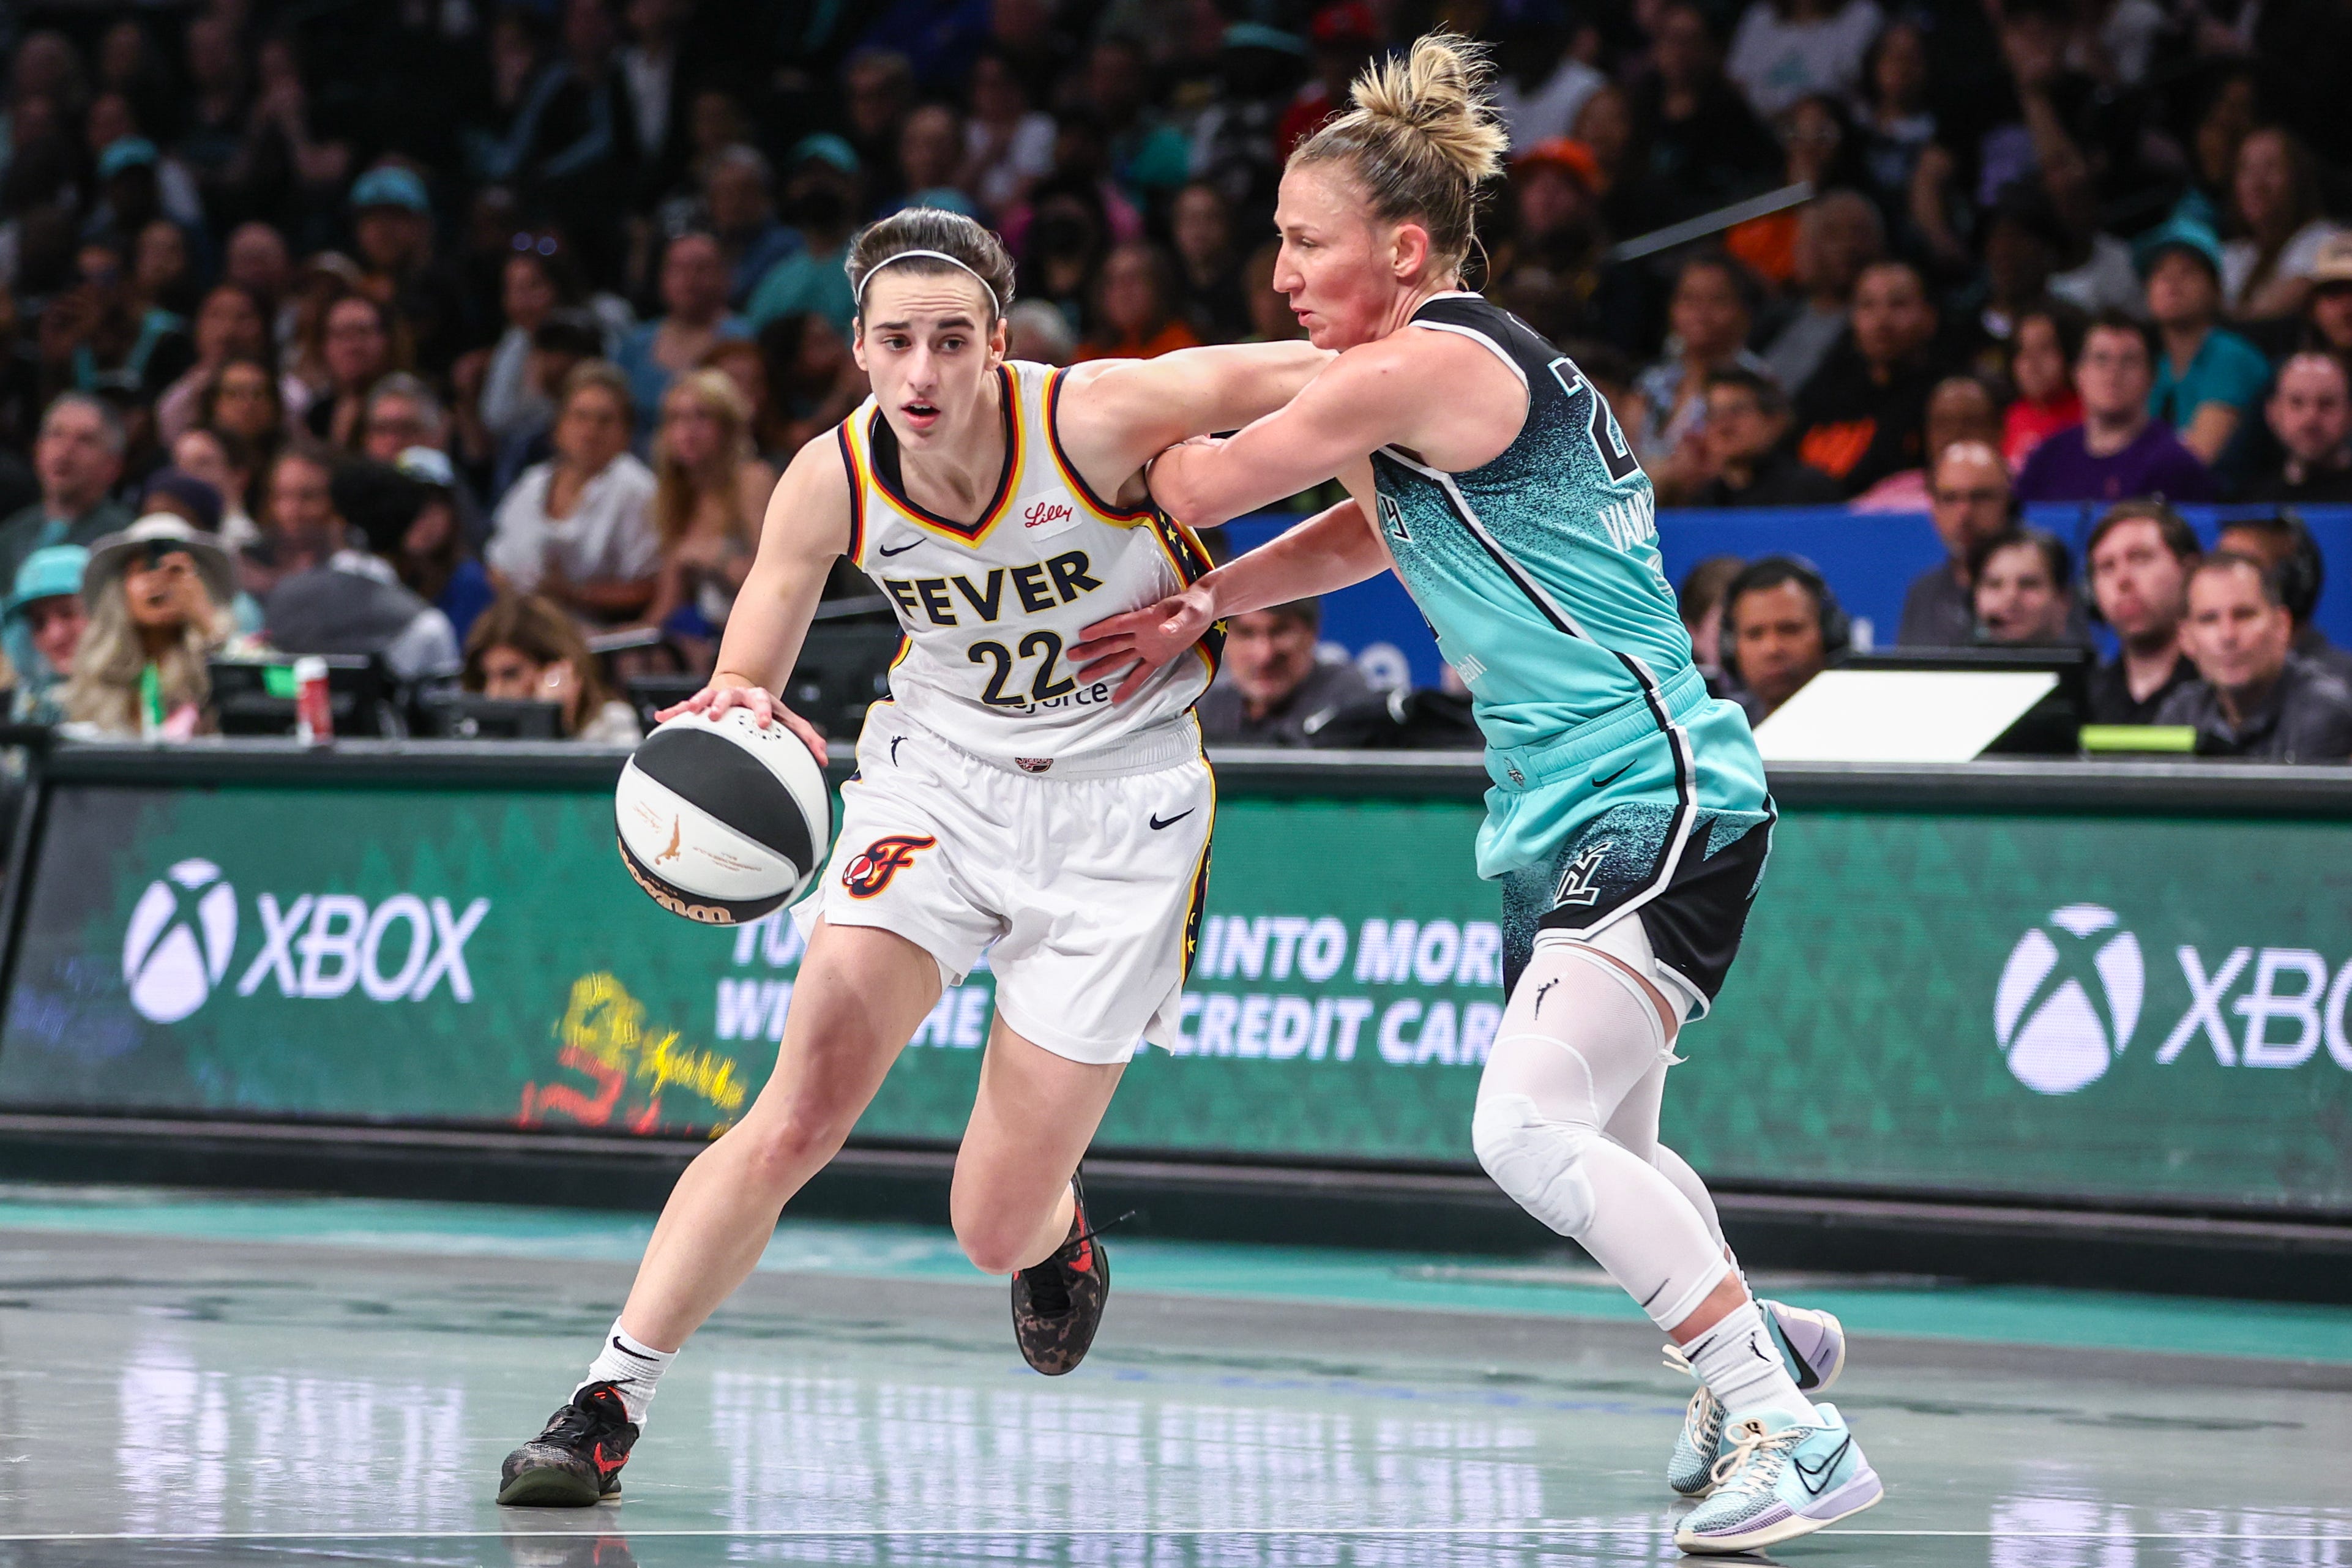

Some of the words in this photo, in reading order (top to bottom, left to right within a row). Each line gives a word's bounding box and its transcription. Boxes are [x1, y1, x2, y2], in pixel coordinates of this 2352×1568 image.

[1024, 501, 1073, 530] Lilly
[881, 550, 1103, 626] FEVER
[968, 629, 1077, 706] 22
[237, 892, 490, 1004] XBOX
[1197, 915, 1347, 983] INTO
[1353, 917, 1504, 987] MOR
[715, 978, 794, 1042] WI
[908, 985, 990, 1048] HE
[1174, 990, 1374, 1062] CREDIT
[1377, 996, 1506, 1066] CAR
[2155, 944, 2352, 1072] XB
